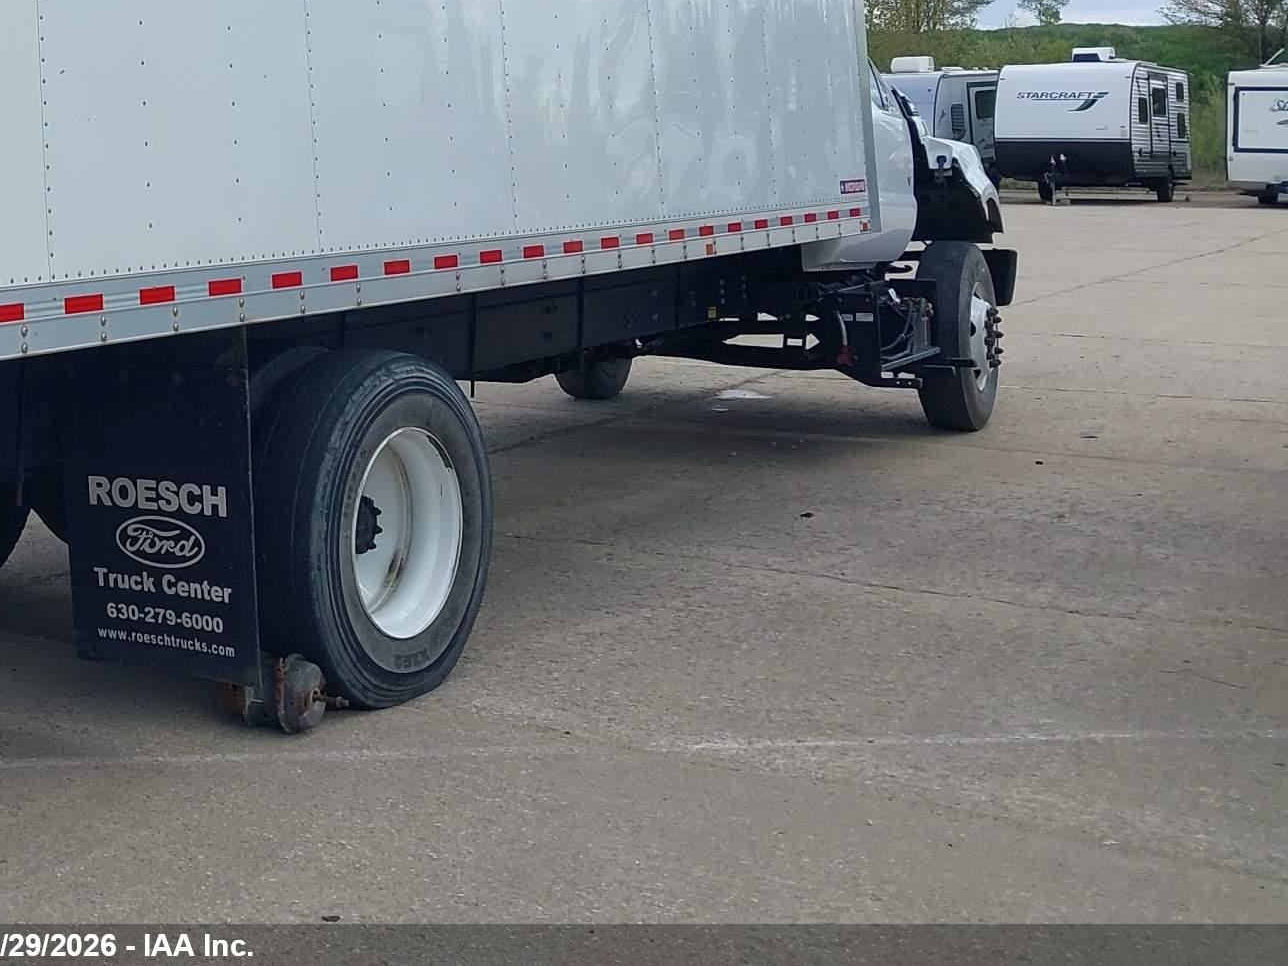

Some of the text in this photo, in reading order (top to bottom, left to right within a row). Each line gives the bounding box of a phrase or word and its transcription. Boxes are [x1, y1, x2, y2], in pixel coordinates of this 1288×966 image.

[1016, 91, 1096, 100] STARCRAFT
[88, 475, 227, 517] ROESCH
[125, 523, 199, 558] Ford
[94, 567, 232, 604] Truck Center
[106, 602, 224, 634] 630-279-6000
[98, 626, 236, 658] www.roeschtrucks.com
